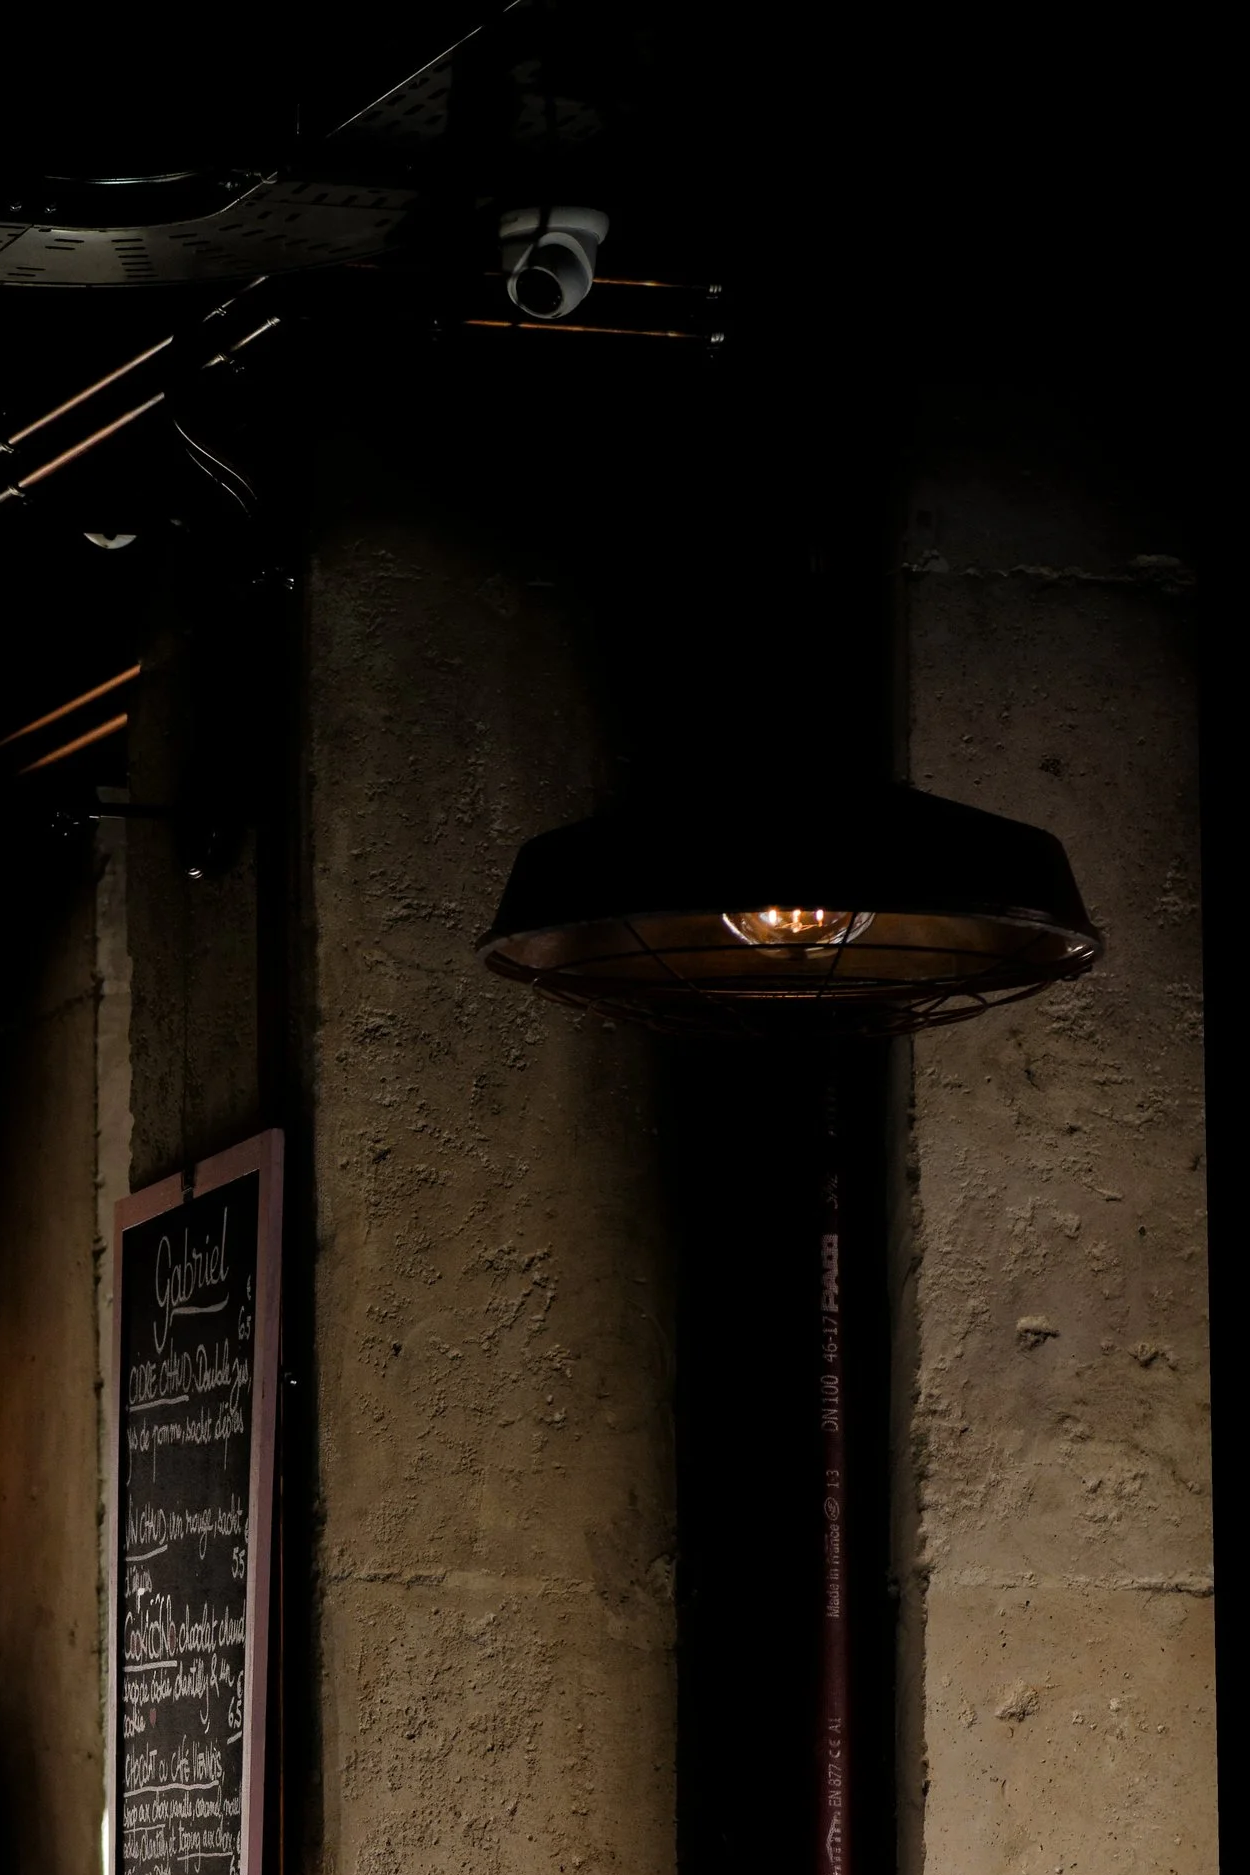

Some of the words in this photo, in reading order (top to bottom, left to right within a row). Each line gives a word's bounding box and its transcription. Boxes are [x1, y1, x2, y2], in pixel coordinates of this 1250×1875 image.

[153, 1206, 230, 1354] Gabriel
[821, 1316, 839, 1363] 46-17
[820, 1375, 839, 1403] 100
[821, 1409, 839, 1433] DN
[826, 1524, 840, 1565] France
[827, 1568, 840, 1580] in
[827, 1584, 840, 1618] Made
[828, 1763, 842, 1787] 877
[828, 1790, 842, 1807] EN
